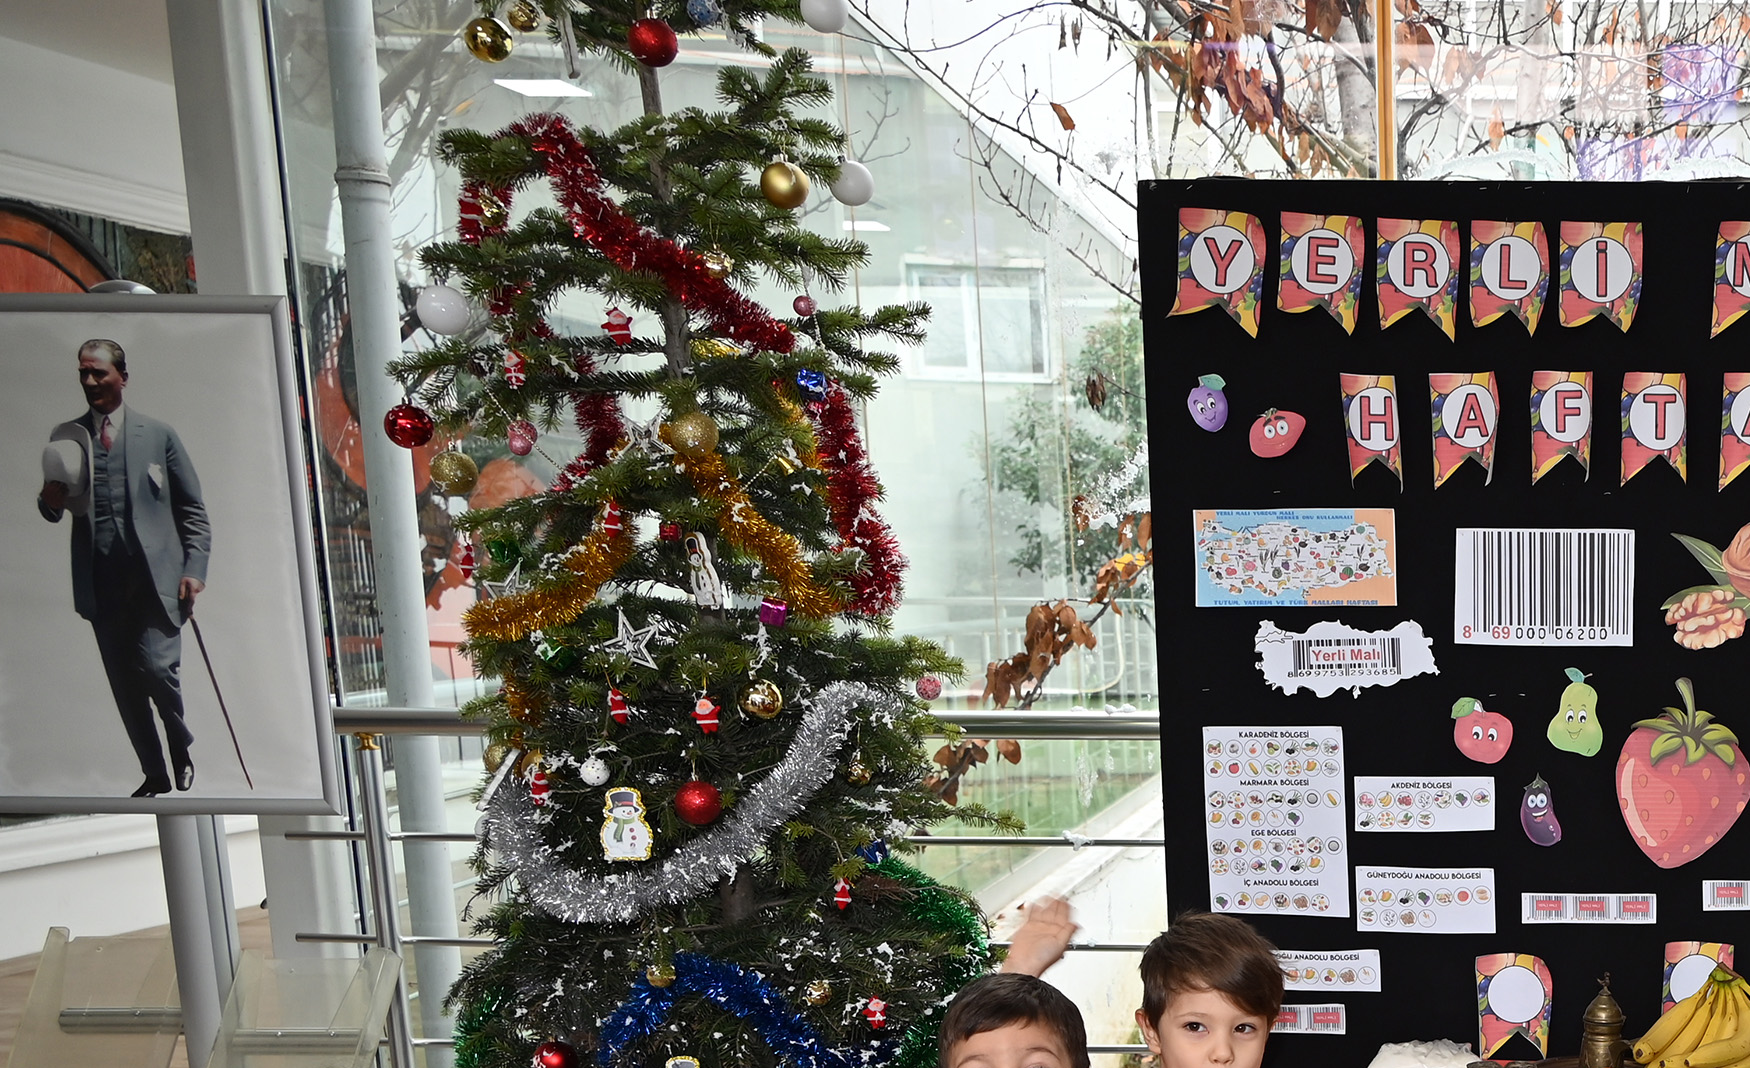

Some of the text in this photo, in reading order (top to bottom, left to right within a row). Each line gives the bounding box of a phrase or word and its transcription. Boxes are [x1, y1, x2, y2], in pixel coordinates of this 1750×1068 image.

[1203, 237, 1608, 298] YERLİ
[1312, 649, 1380, 662] Yerli Malı
[1239, 730, 1279, 738] KARADENİZ
[1391, 781, 1420, 789] AKDENİZ
[1366, 870, 1413, 879] GÜNEYDOĞU
[1294, 953, 1328, 961] ANADOLU
